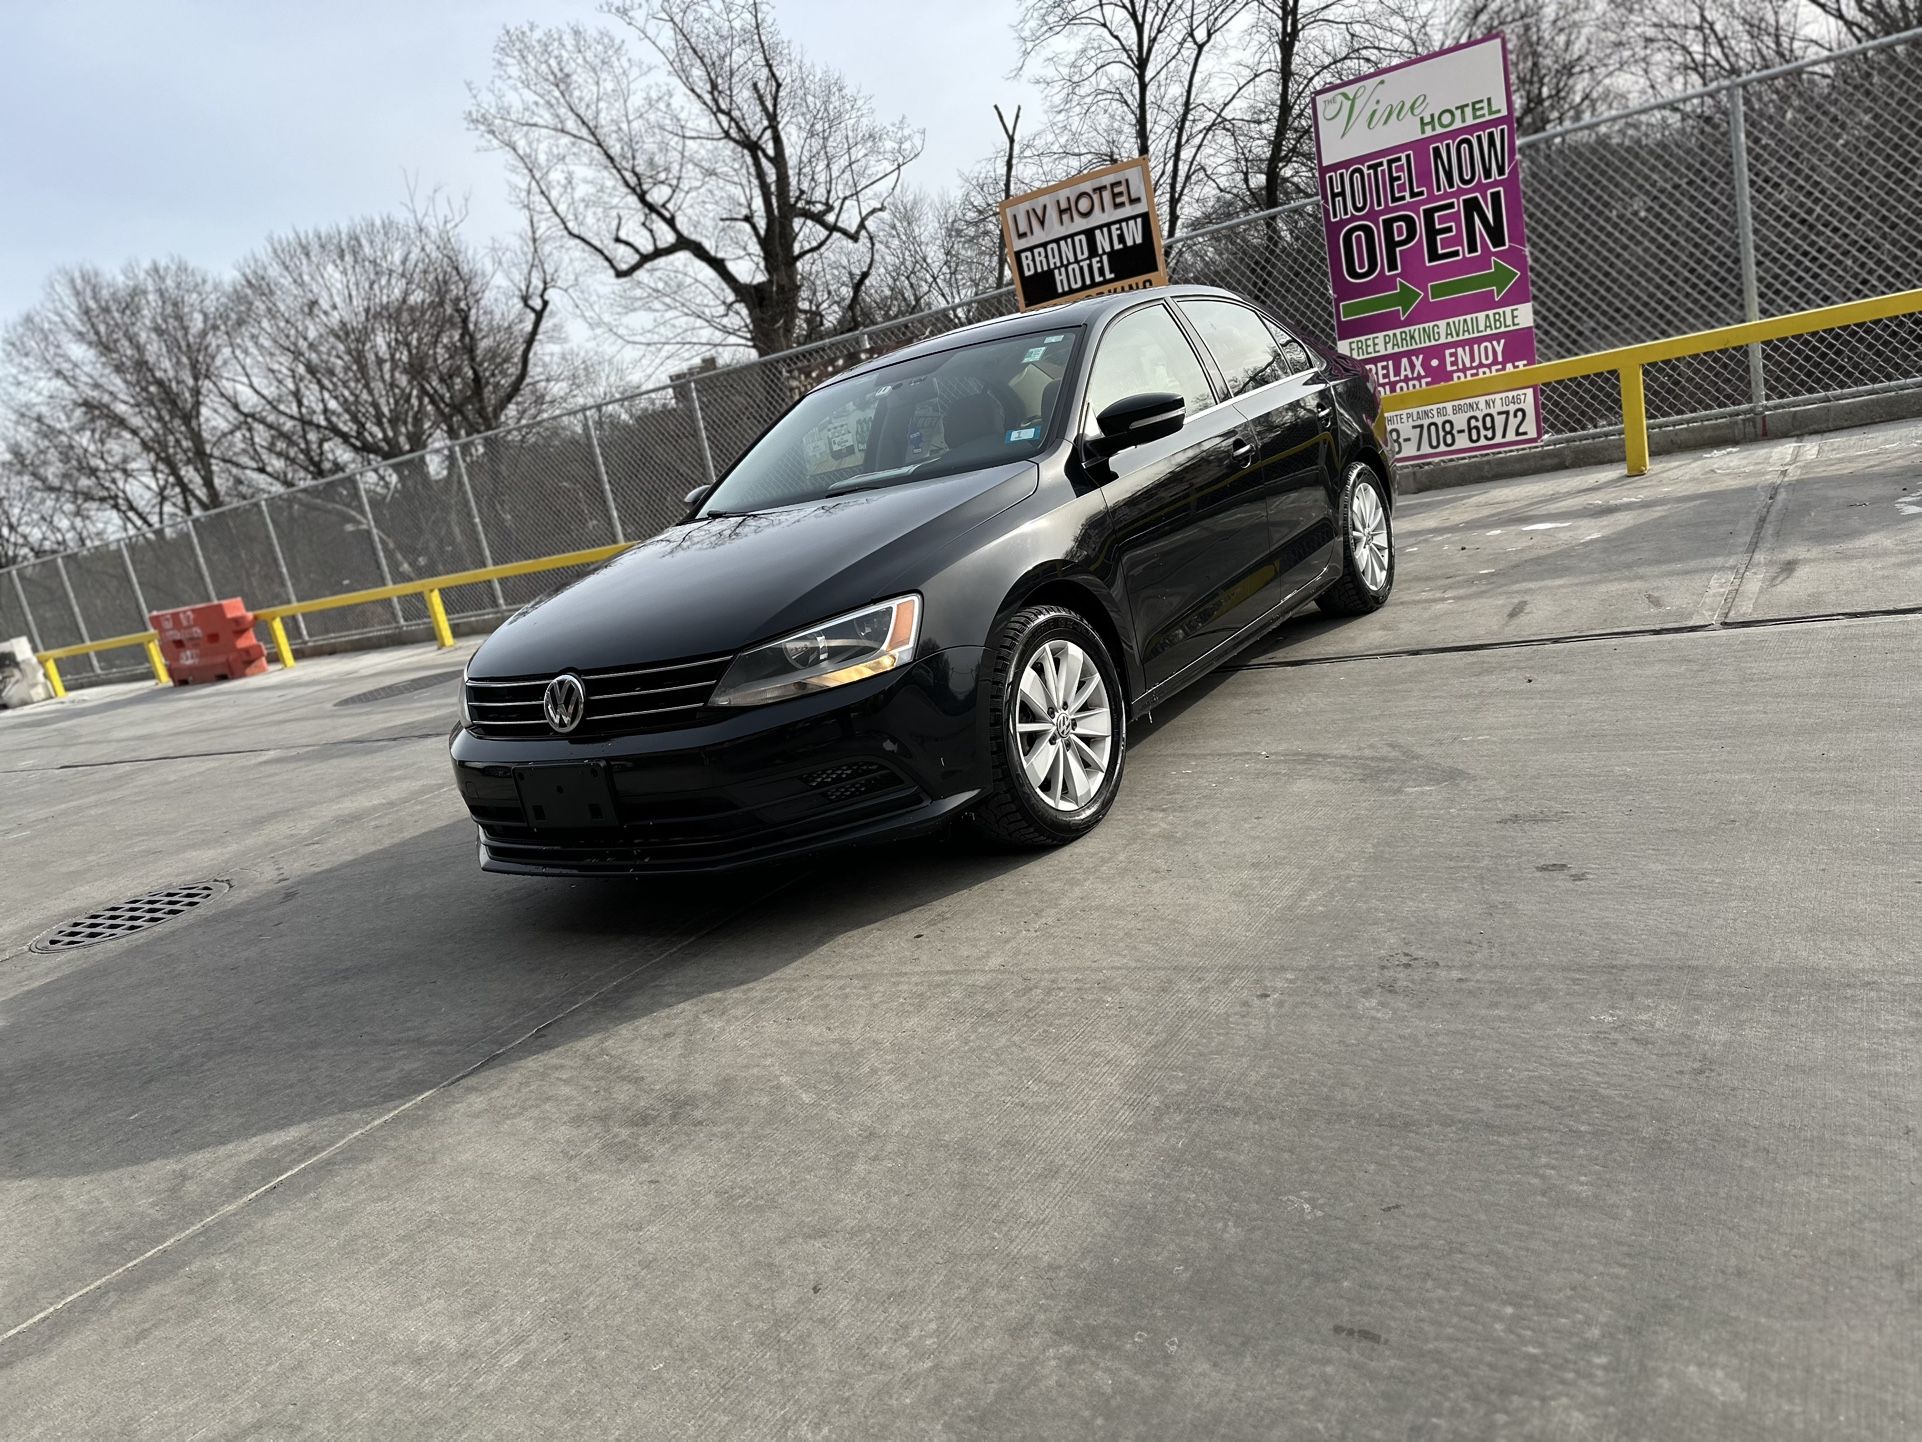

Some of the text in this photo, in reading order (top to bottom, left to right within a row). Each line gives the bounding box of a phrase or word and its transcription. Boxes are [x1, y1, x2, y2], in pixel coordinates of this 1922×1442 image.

[1322, 79, 1428, 139] THE Vine
[1419, 97, 1501, 135] HOTEL
[1326, 125, 1508, 221] HOTEL NOW
[1013, 178, 1142, 240] LIV HOTEL
[1340, 187, 1509, 283] OPEN
[1021, 218, 1143, 277] BRAND NEW
[1054, 255, 1115, 293] HOTEL
[1349, 308, 1520, 358] FREE PARKING AVAILABLE
[1445, 339, 1505, 371] ENJOY
[1406, 408, 1435, 423] PLAINS
[1436, 406, 1451, 418] RD.
[1452, 400, 1484, 415] BRONX,
[1485, 398, 1497, 410] NY
[1499, 392, 1527, 407] 10467
